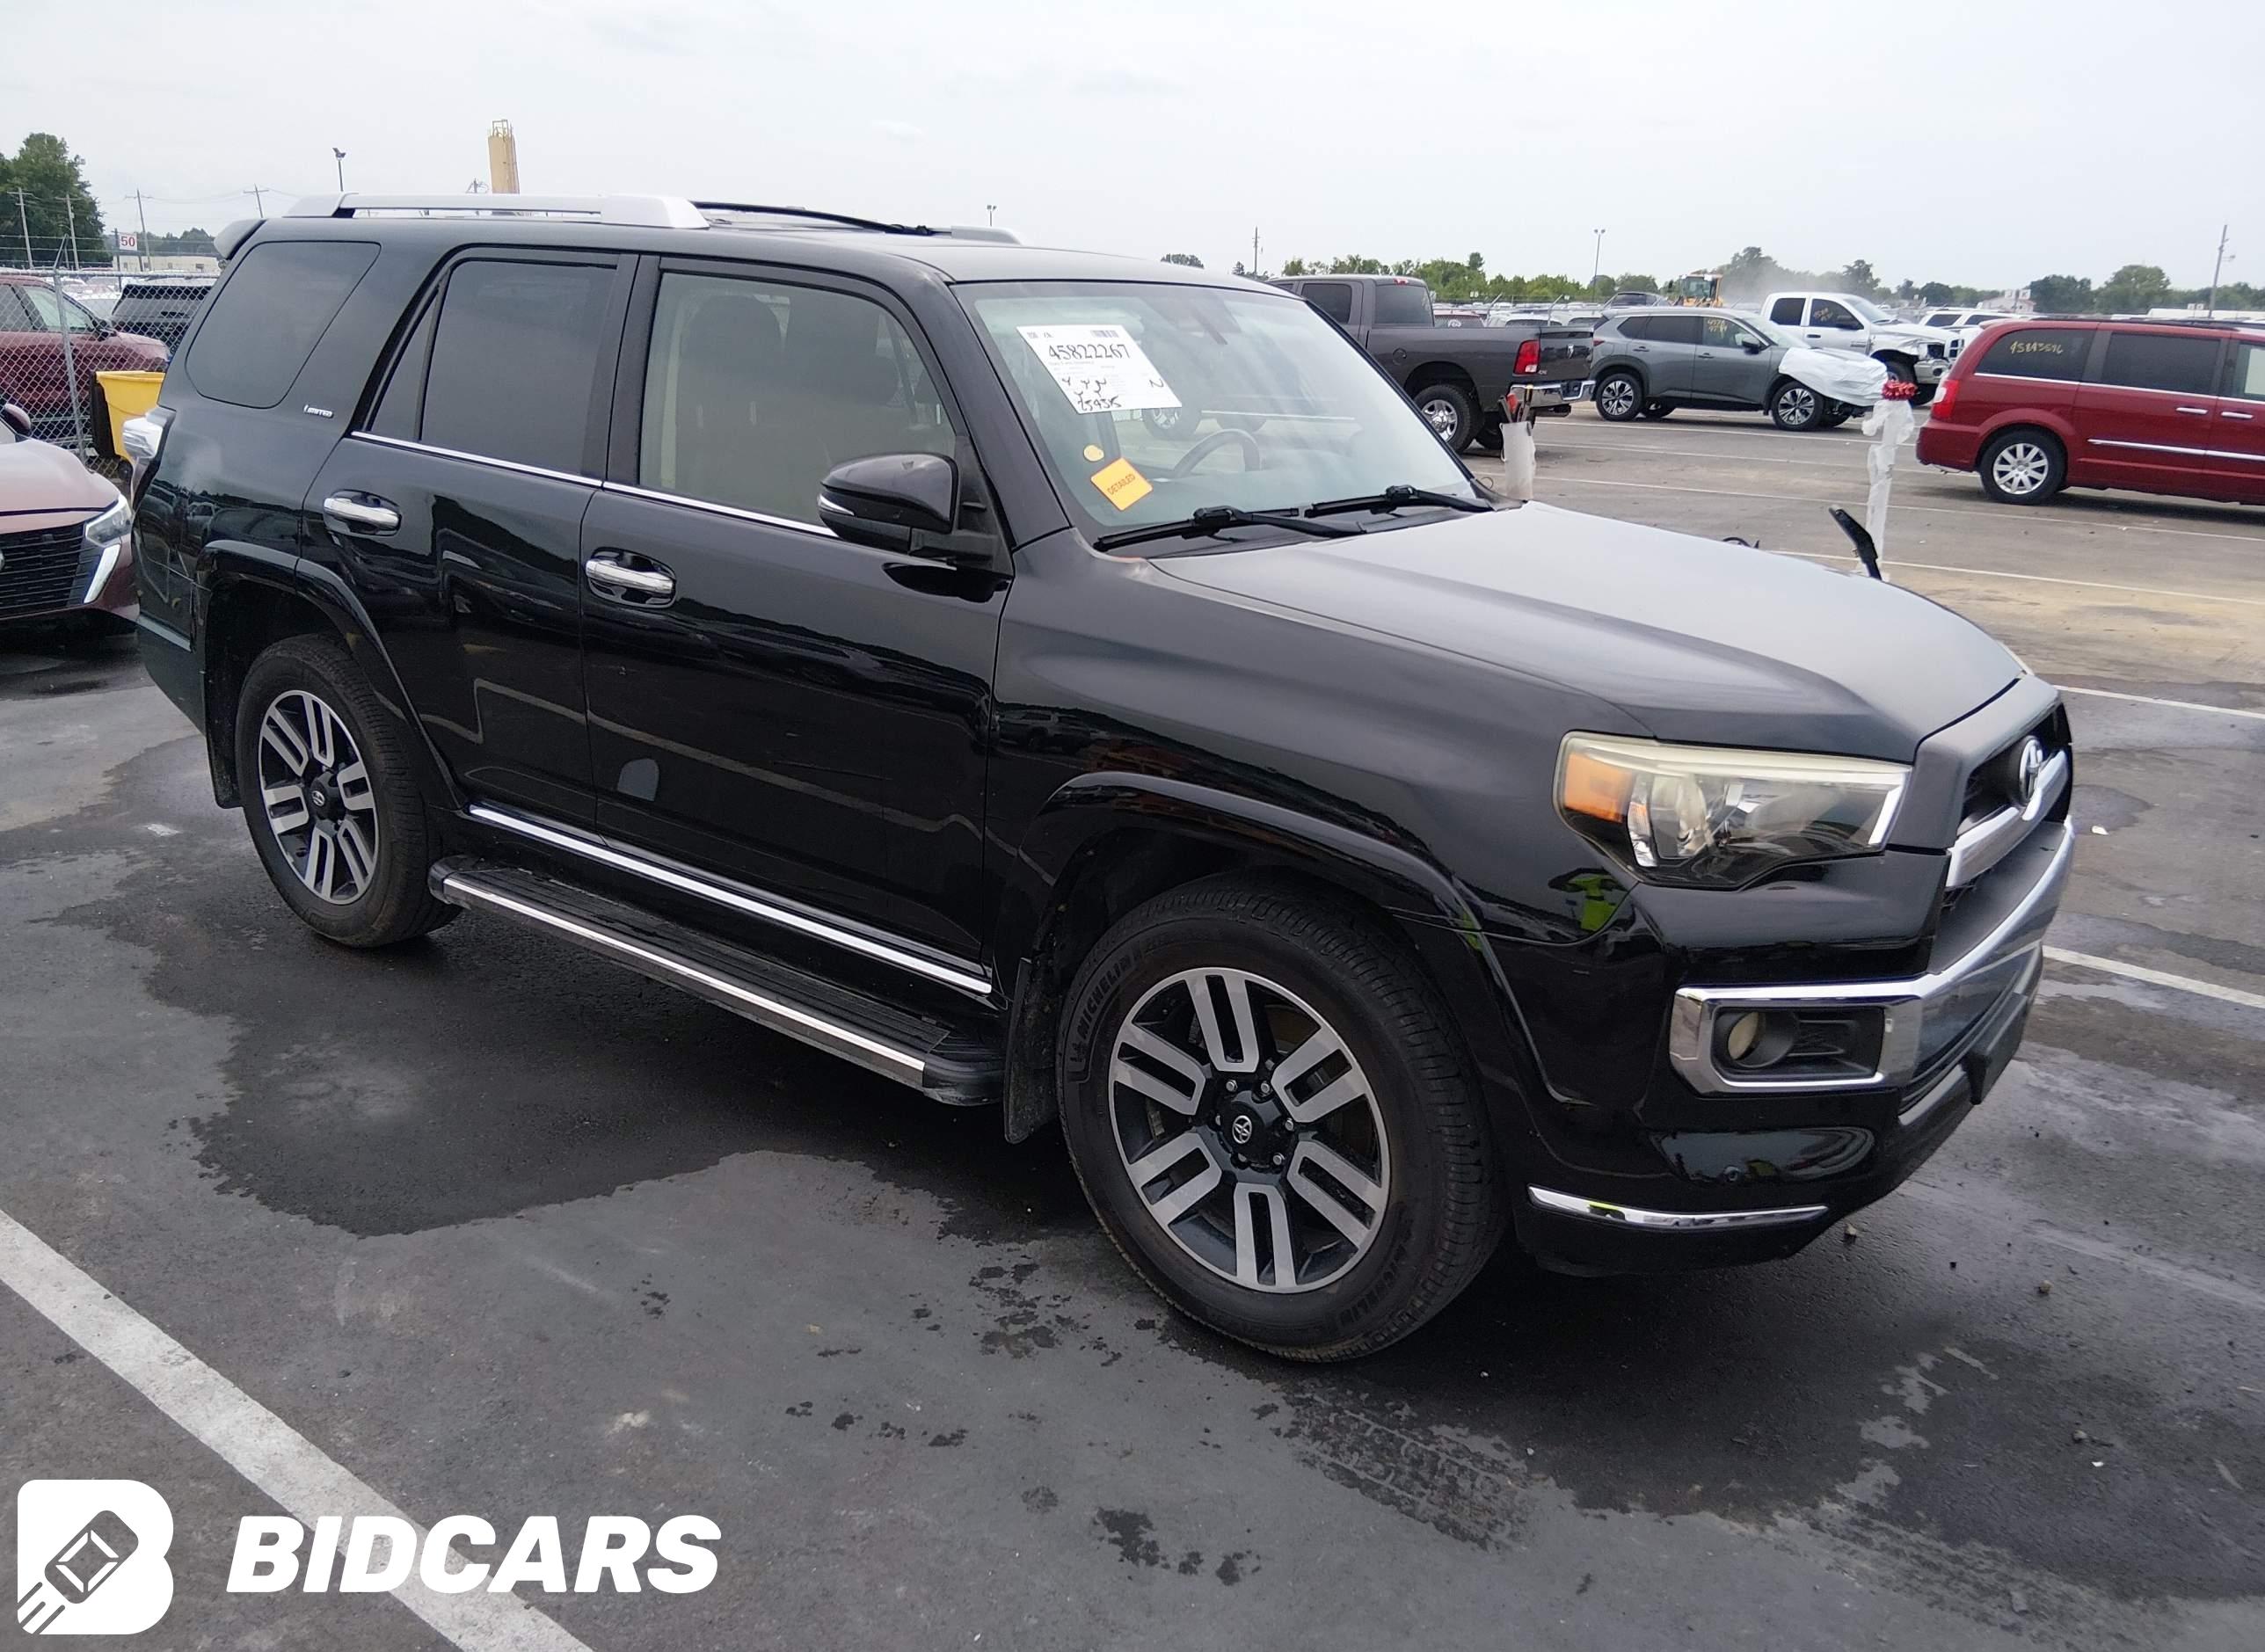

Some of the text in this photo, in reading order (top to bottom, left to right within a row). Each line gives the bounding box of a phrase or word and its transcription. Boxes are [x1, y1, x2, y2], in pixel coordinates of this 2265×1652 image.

[120, 236, 135, 247] 50
[1049, 344, 1131, 360] 45822267
[1076, 955, 1132, 1040] MICHELIN
